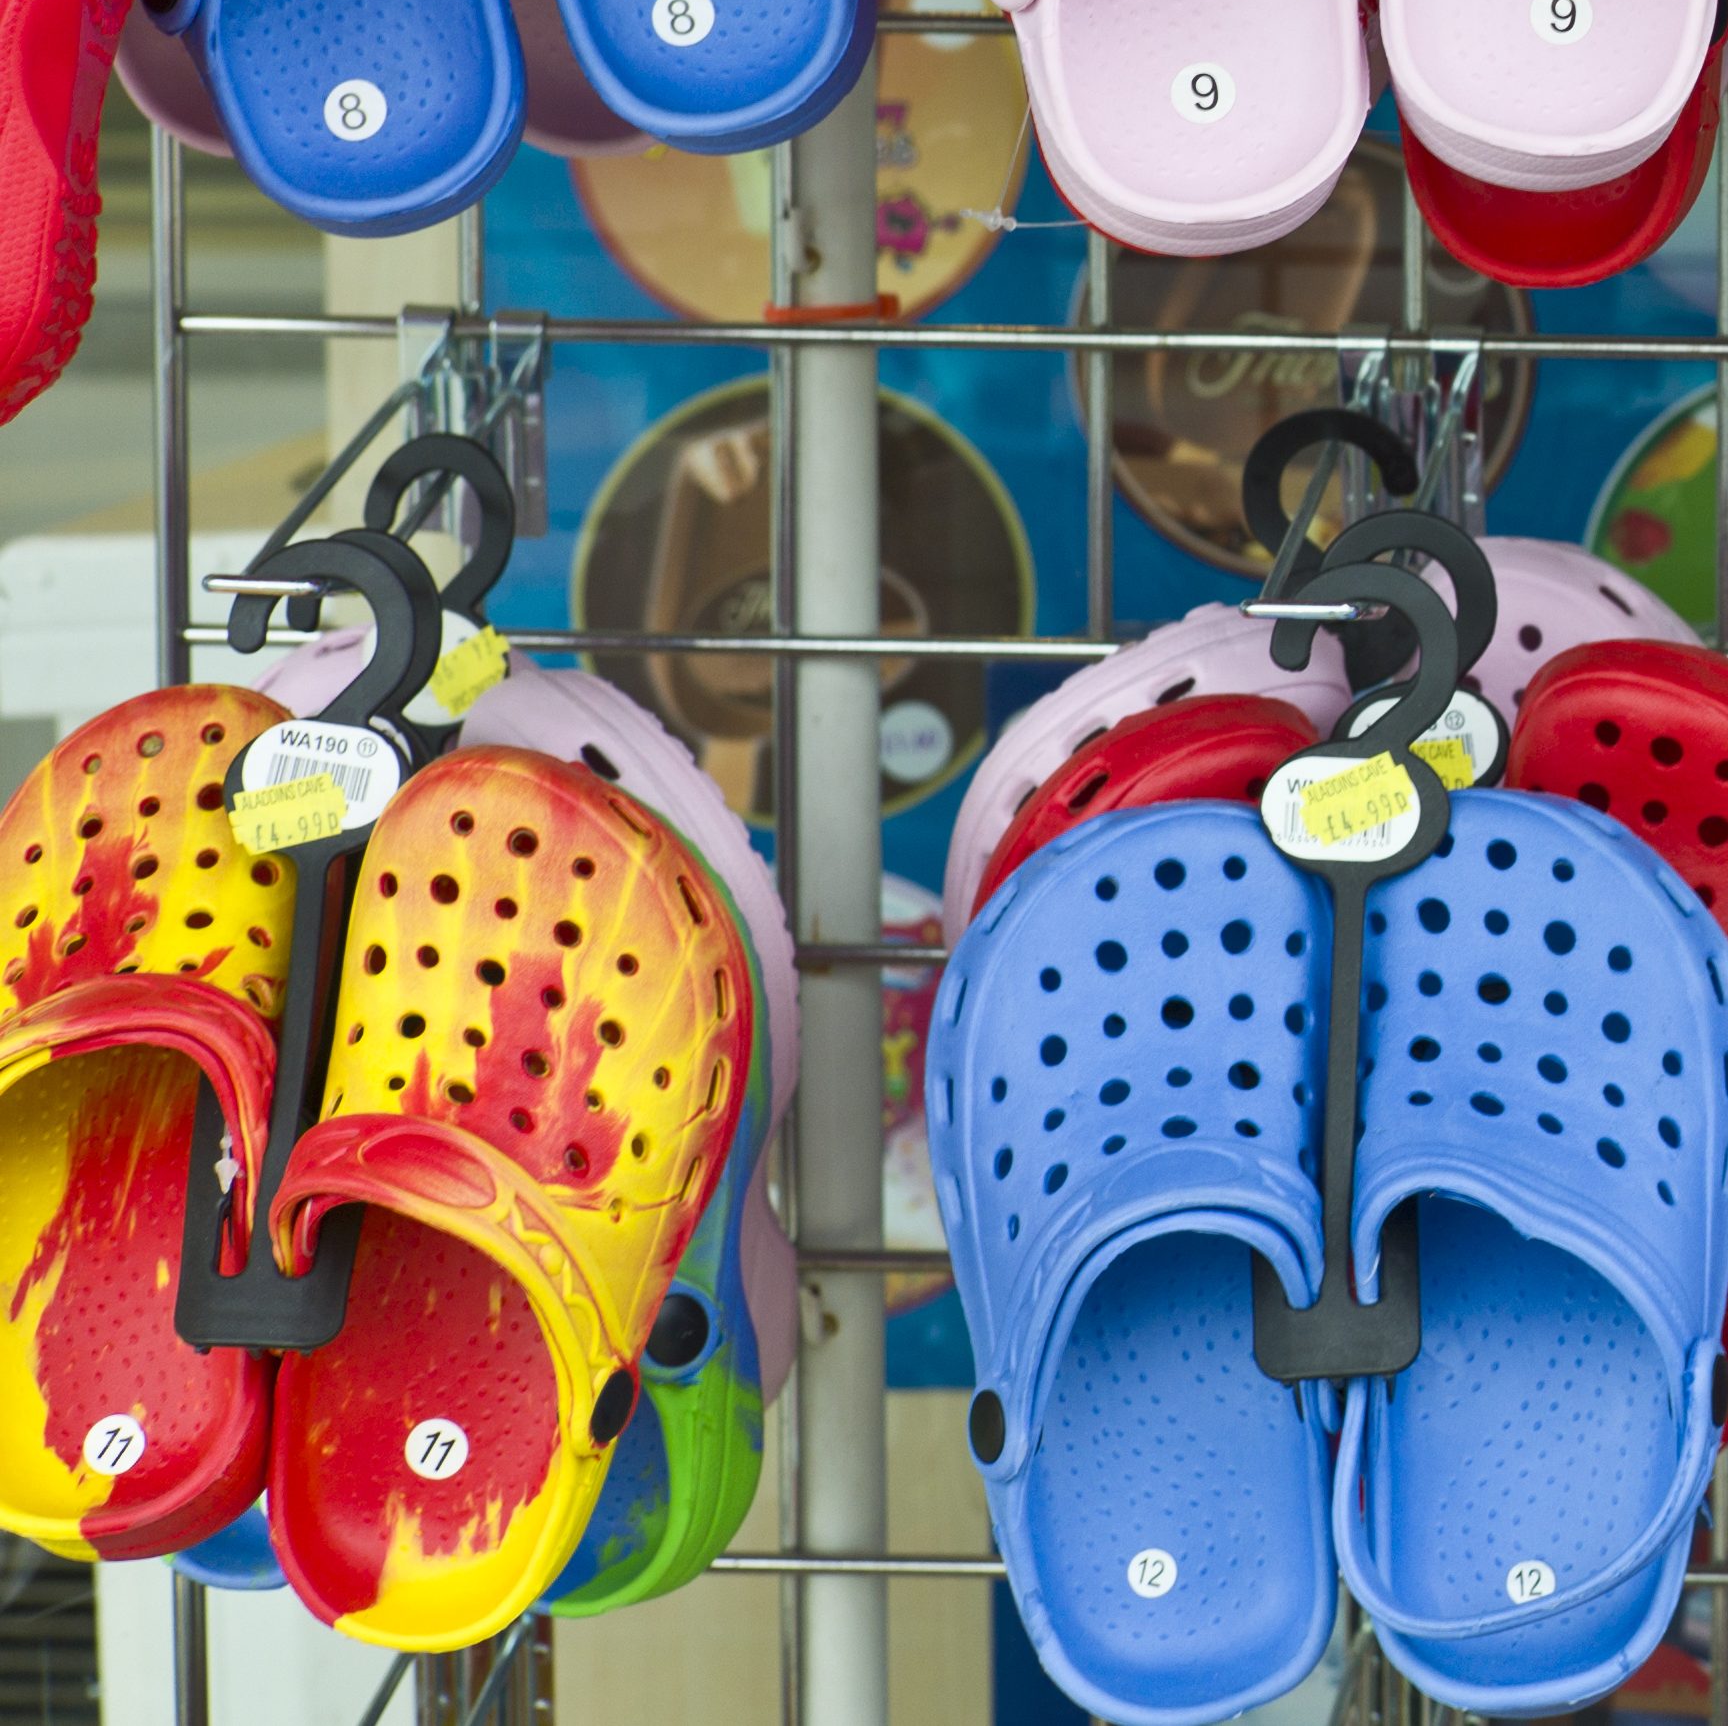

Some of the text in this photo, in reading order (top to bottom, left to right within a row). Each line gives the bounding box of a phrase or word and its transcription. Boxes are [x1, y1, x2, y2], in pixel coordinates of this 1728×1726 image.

[667, 0, 695, 34] 8
[1190, 73, 1218, 111] 9
[339, 94, 366, 129] 8
[280, 729, 348, 755] WA190
[1428, 743, 1455, 760] CAVE
[242, 780, 327, 811] ALADDINS CAVE
[1307, 772, 1359, 805] ALADDINS
[1359, 759, 1388, 782] CAVE
[255, 813, 339, 850] £4.99p
[1323, 791, 1408, 842] £4.99p
[98, 1428, 133, 1467] 11
[421, 1431, 455, 1471] 11
[1137, 1558, 1163, 1587] 12
[1514, 1568, 1542, 1596] 12
